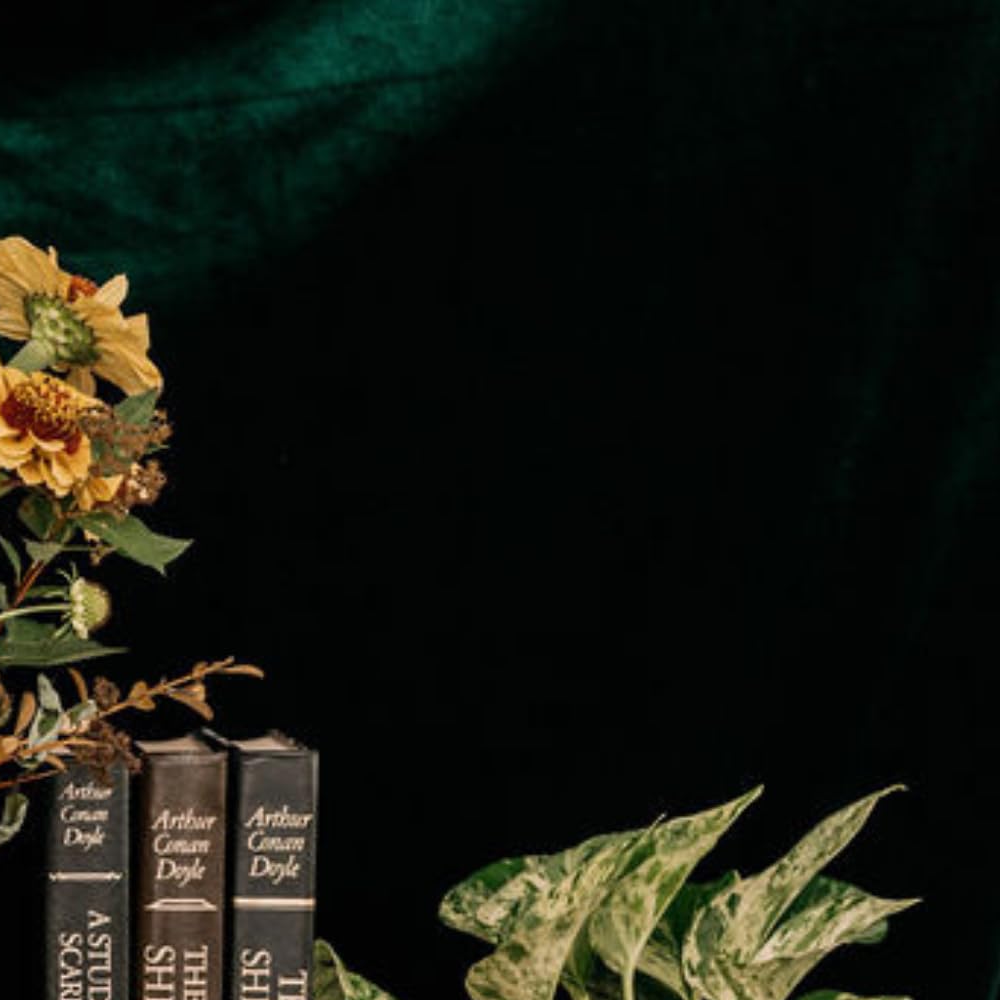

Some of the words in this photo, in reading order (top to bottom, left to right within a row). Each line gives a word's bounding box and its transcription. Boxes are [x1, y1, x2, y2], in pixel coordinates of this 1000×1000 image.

[60, 780, 113, 800] Arthur
[61, 805, 109, 823] Conan
[152, 807, 218, 832] Arthur
[245, 804, 313, 830] Arthur
[63, 827, 106, 851] Doyle
[154, 834, 211, 856] Conan
[248, 832, 305, 854] Conan
[156, 858, 207, 888] Doyle
[249, 855, 302, 886] Doyle
[87, 909, 112, 929] A
